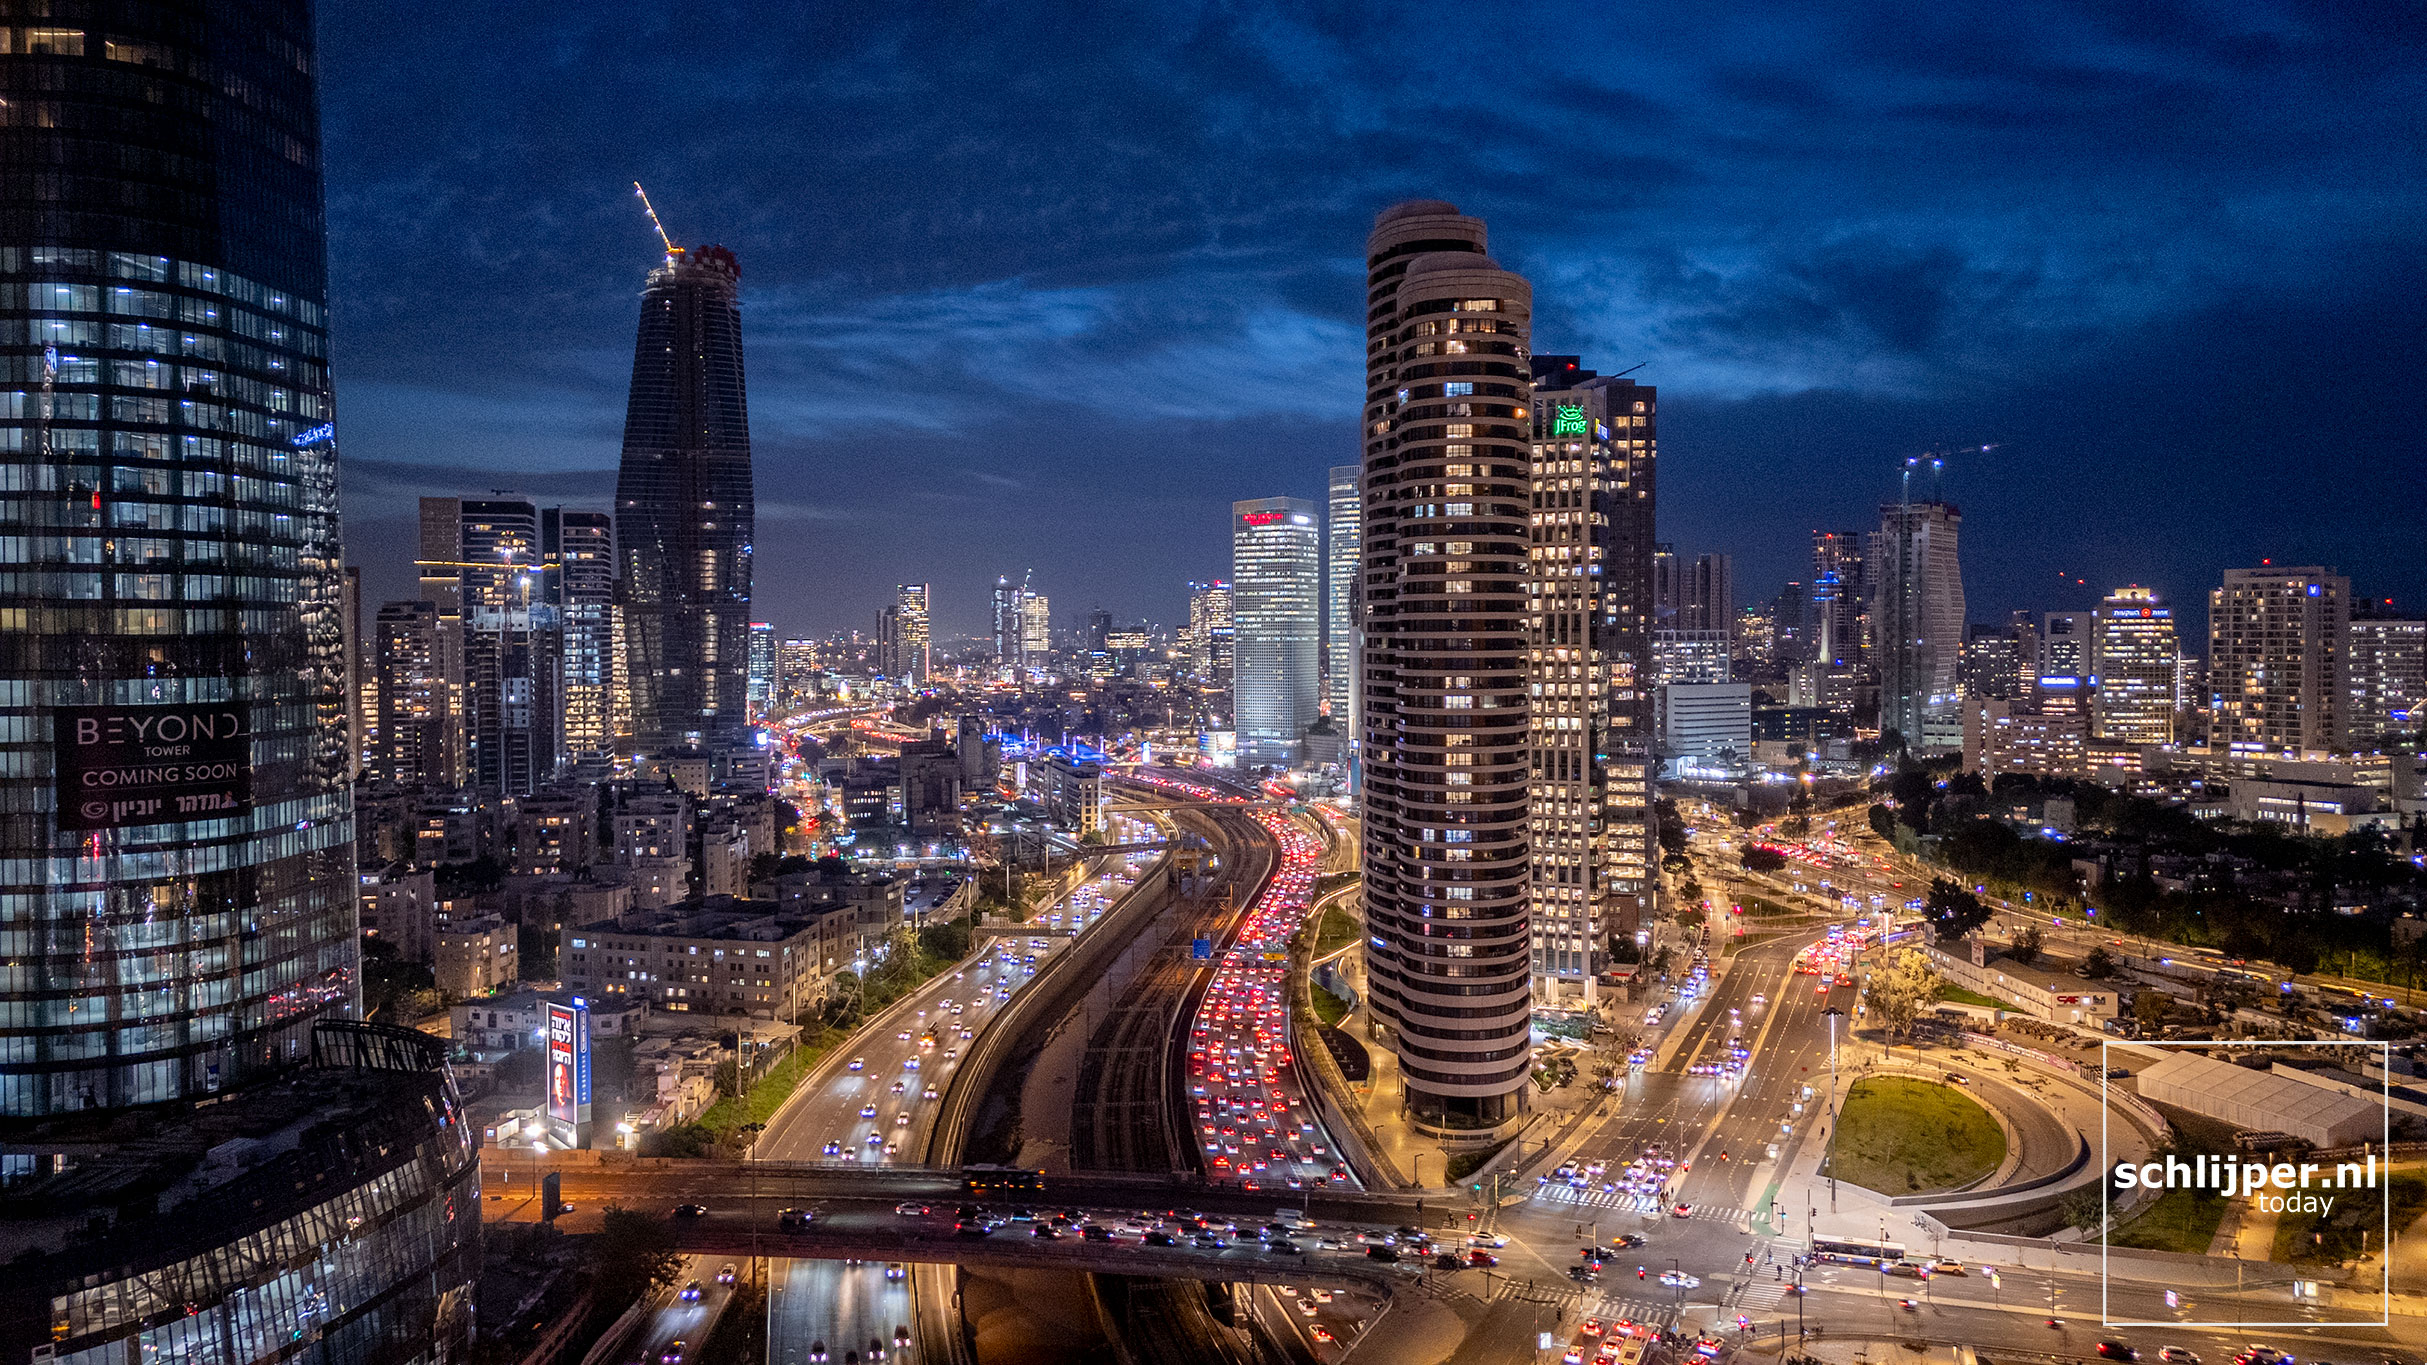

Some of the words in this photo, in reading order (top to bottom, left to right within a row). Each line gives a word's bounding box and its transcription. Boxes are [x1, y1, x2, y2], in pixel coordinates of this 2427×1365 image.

[1555, 419, 1588, 434] JFrog
[77, 713, 239, 745] BEYOND
[144, 745, 190, 758] TOWER
[82, 765, 179, 787] COMING
[185, 763, 237, 781] SOON
[112, 798, 162, 823] יוניון
[175, 793, 221, 813] תדהר
[2057, 996, 2080, 1004] CAF
[552, 1016, 571, 1032] איזה
